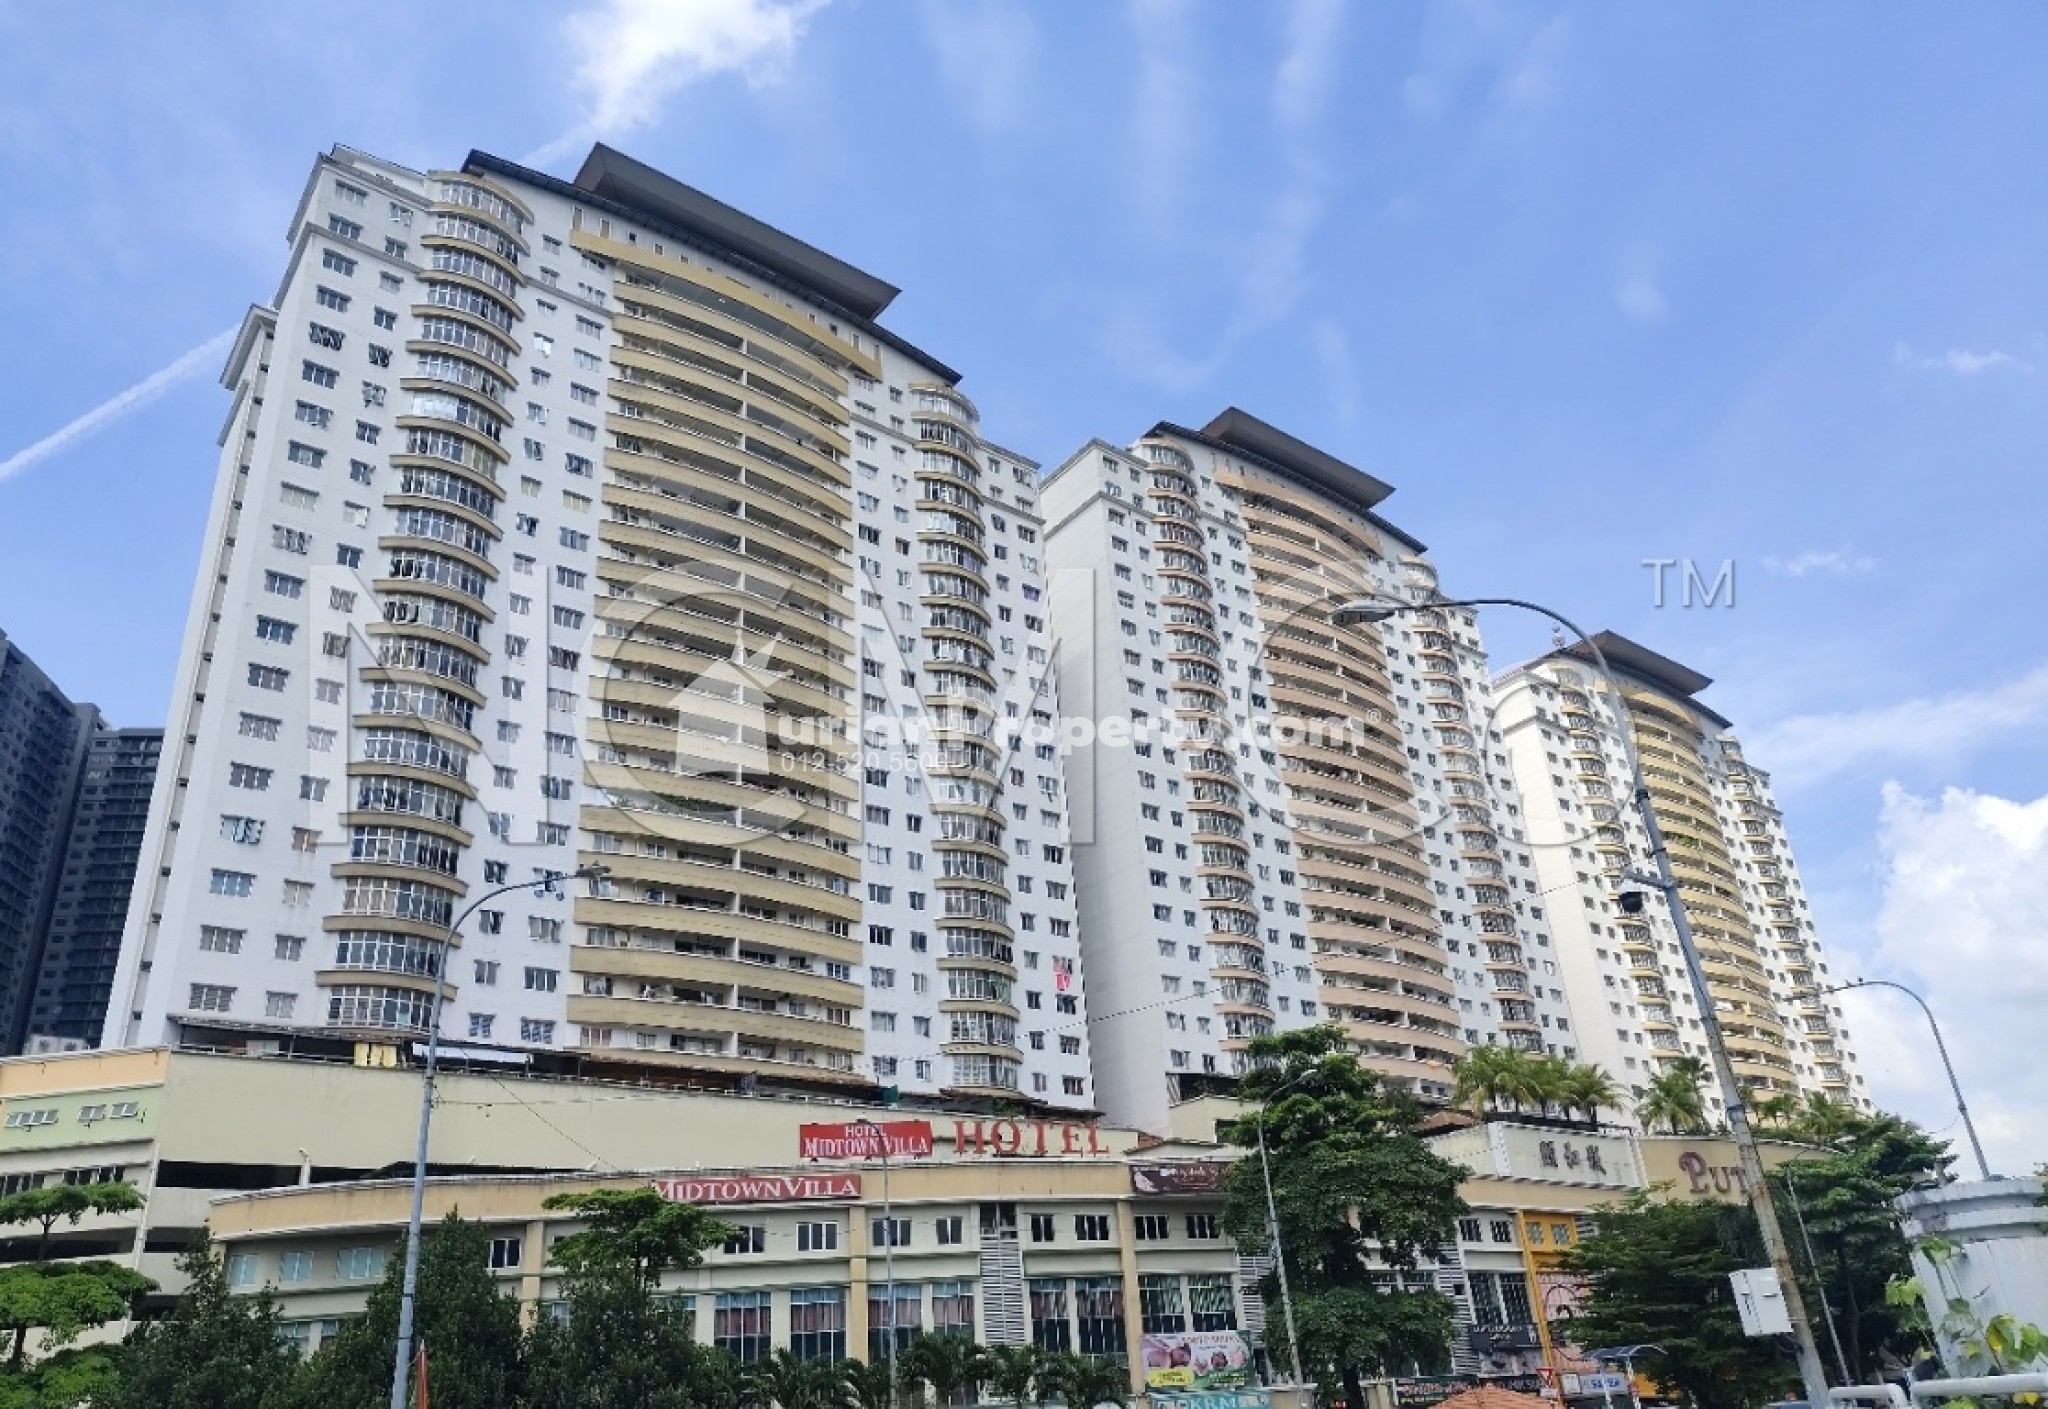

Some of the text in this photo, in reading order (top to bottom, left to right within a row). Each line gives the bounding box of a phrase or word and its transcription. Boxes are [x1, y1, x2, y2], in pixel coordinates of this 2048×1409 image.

[845, 1124, 887, 1137] HOTEL
[952, 1118, 1111, 1155] HOTEL
[881, 1135, 930, 1155] VILLA
